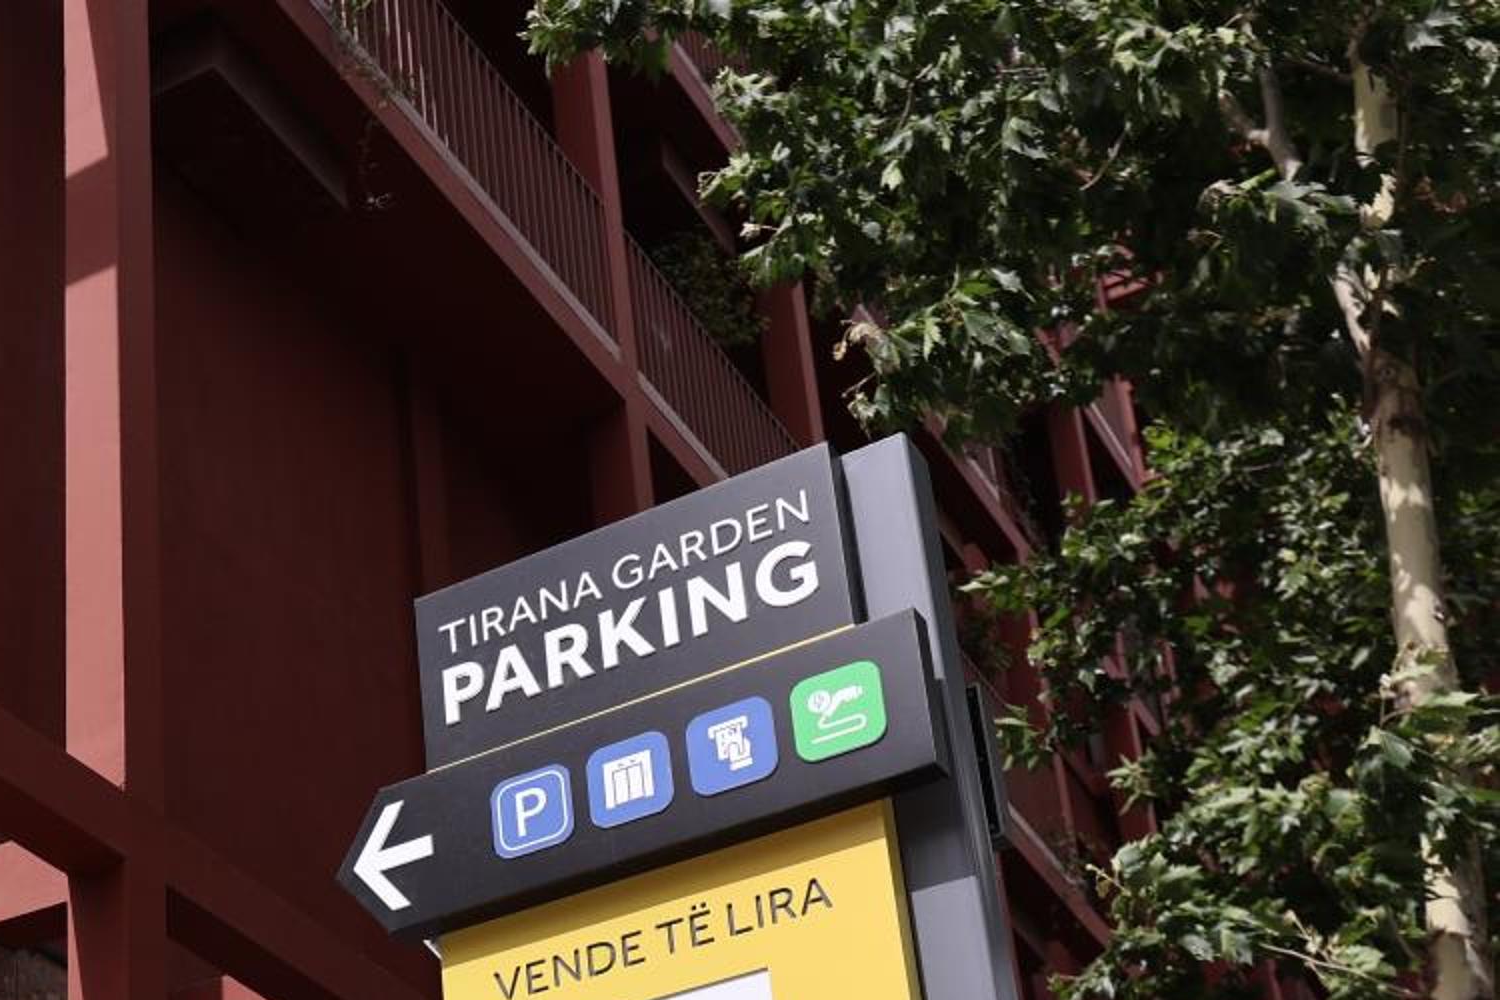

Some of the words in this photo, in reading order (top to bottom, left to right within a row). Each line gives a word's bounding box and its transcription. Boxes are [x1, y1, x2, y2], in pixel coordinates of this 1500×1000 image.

[439, 571, 602, 653] TIRANA
[612, 489, 811, 590] GARDEN
[441, 540, 820, 726] PARKING
[515, 788, 547, 837] P
[494, 930, 646, 1000] VENDE
[655, 903, 715, 955] TË
[728, 877, 833, 938] LIRA
